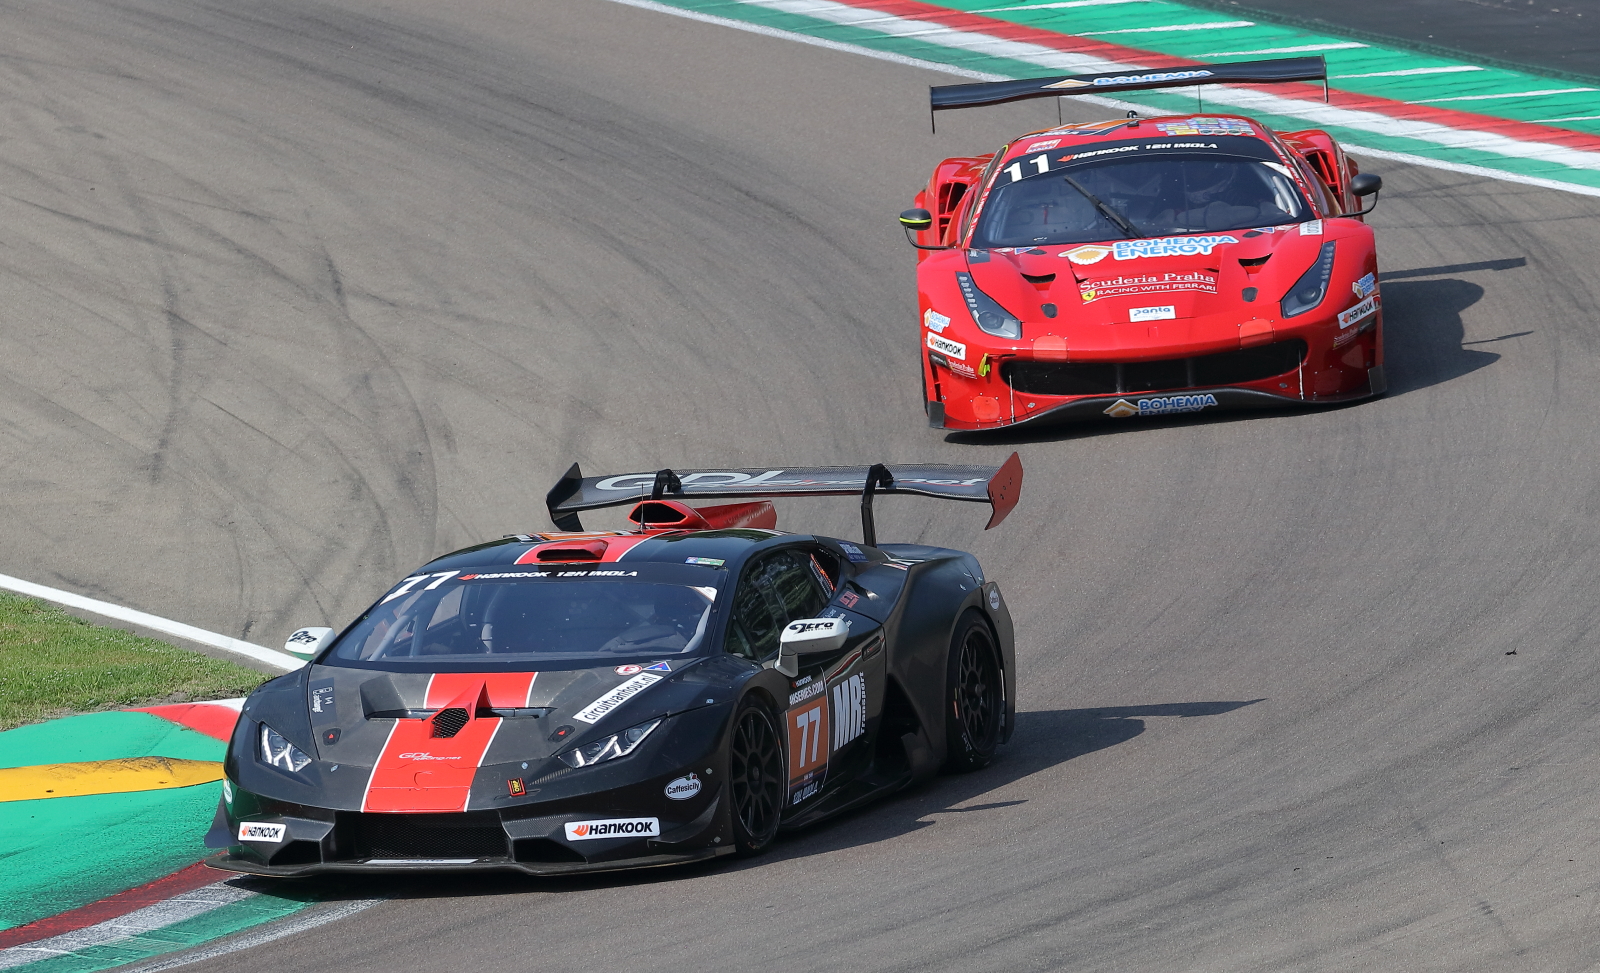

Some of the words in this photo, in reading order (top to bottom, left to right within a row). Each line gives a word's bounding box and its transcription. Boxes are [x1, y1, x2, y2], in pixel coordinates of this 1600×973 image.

[1003, 153, 1050, 182] 11
[1115, 236, 1237, 250] BOHEMIA
[1117, 244, 1213, 258] ENERGY
[1080, 274, 1157, 291] Scuderia
[1163, 271, 1216, 283] Praha
[1096, 286, 1139, 296] RACING
[1140, 284, 1170, 292] WITH
[1172, 282, 1216, 292] FERRARI
[1139, 394, 1216, 411] BOHEMIA
[584, 675, 658, 721] circuitvanhout.nl
[833, 675, 862, 752] MR
[796, 706, 821, 769] 77
[667, 781, 700, 795] Caffesicily
